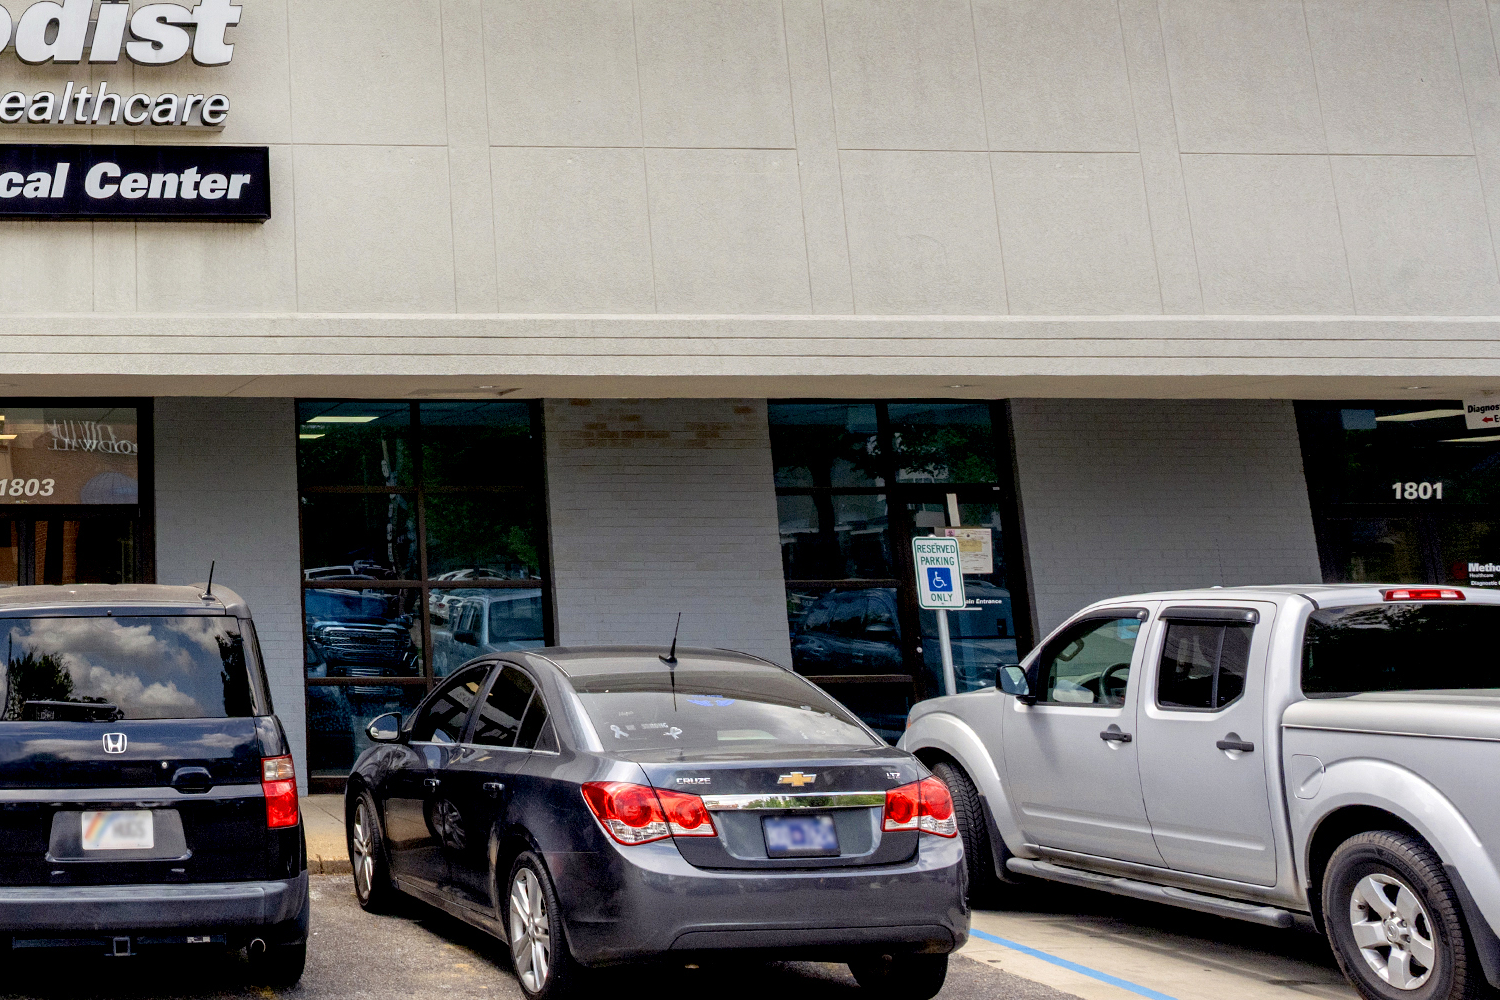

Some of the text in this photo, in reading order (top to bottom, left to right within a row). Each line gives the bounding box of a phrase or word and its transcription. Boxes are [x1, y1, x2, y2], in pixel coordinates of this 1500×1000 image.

[84, 162, 250, 199] Center
[1392, 481, 1443, 500] 1801
[916, 544, 956, 554] RESERVED
[920, 556, 955, 566] PARKING
[930, 593, 953, 602] ONLY
[676, 777, 712, 785] CRUZE
